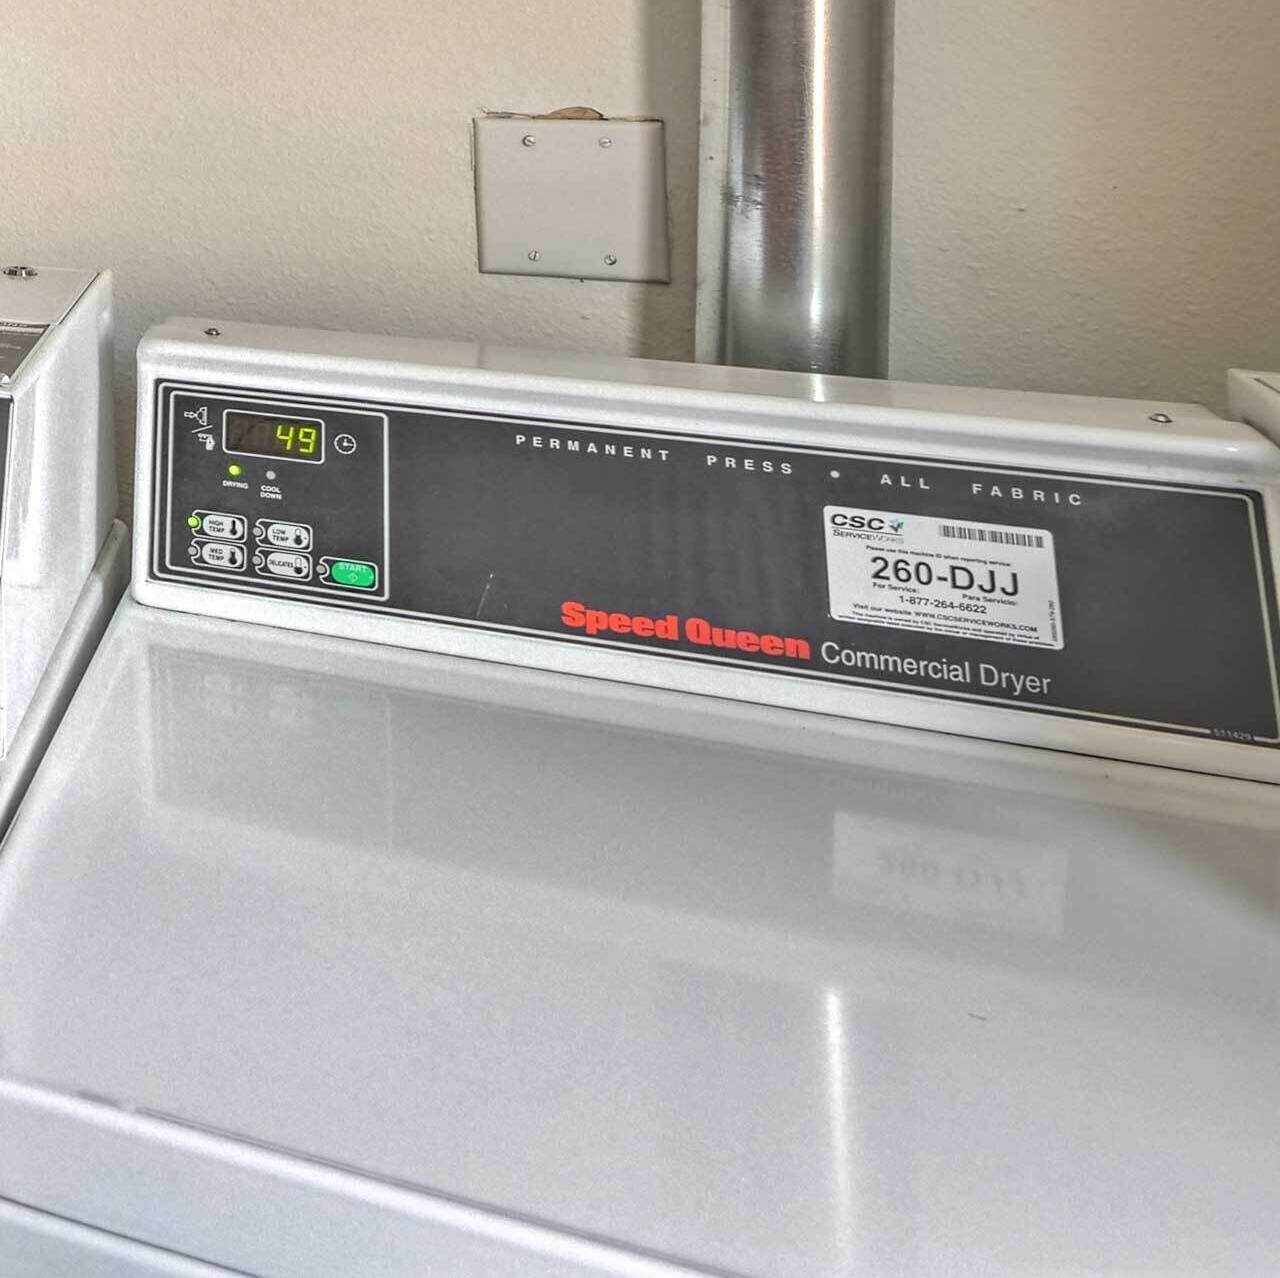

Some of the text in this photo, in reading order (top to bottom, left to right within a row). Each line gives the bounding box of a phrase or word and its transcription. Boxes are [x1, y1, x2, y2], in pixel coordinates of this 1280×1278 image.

[275, 426, 317, 454] 49
[515, 434, 1084, 507] PERMANENT PRESS ALL FABRIC
[222, 480, 249, 489] DRYING
[260, 485, 281, 494] COOL
[260, 491, 282, 500] DOWN
[208, 520, 224, 528] HIGH
[831, 513, 885, 531] CSC
[209, 525, 225, 534] TEMP
[272, 534, 289, 542] TEMP
[833, 529, 905, 544] SERVICEWORKS
[209, 547, 223, 555] MED
[865, 544, 885, 552] Please
[960, 557, 988, 565] reporting
[208, 554, 225, 562] TEMP
[269, 559, 294, 569] DELICATES
[339, 562, 367, 573] START
[870, 556, 1019, 597] 260-DJJ
[872, 581, 886, 589] For
[962, 593, 981, 602] Para
[898, 595, 988, 615] 1-877-264-6622
[884, 608, 912, 616] website
[560, 600, 679, 644] Speed
[683, 616, 810, 660] Queen
[820, 639, 972, 685] Commercial
[978, 661, 1053, 696] Dryer
